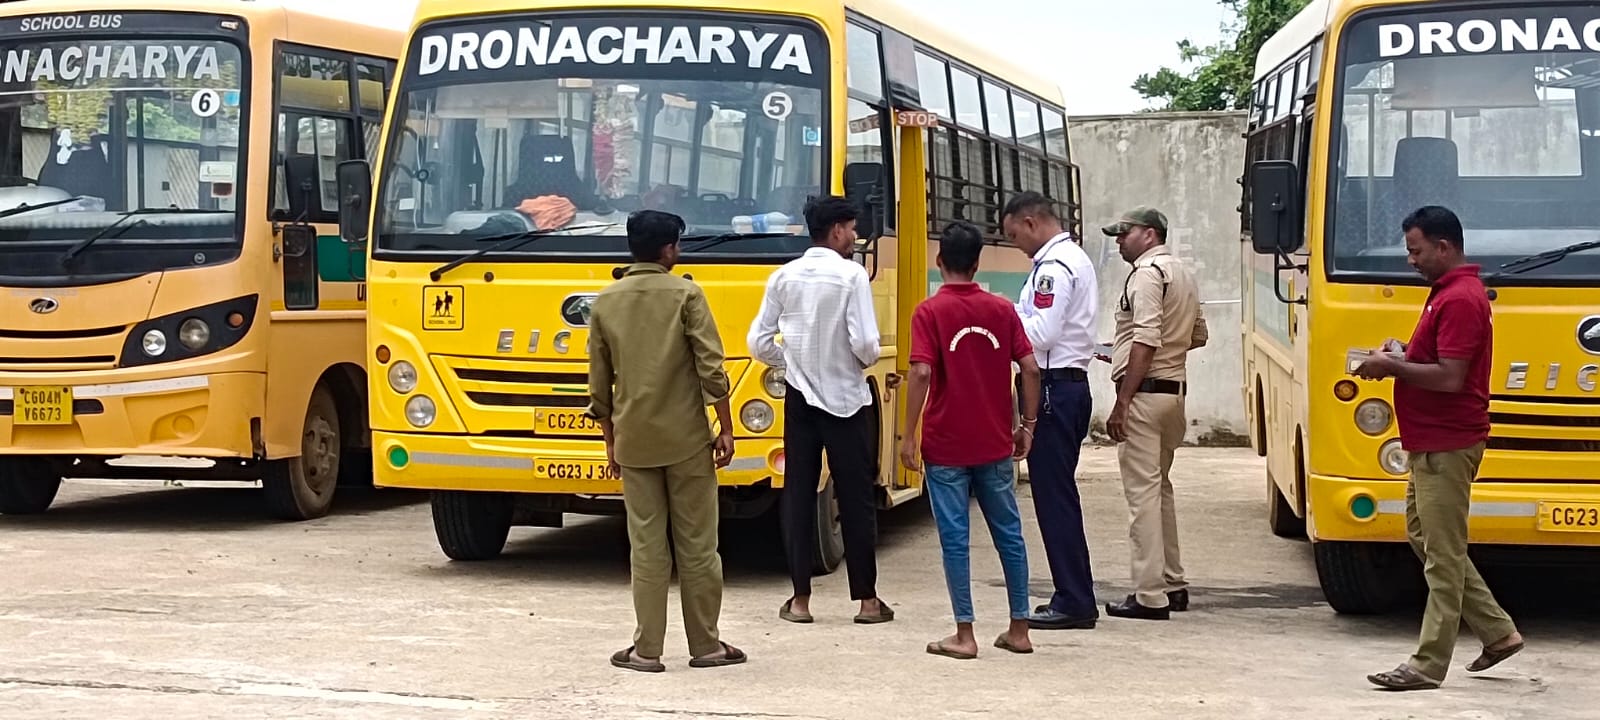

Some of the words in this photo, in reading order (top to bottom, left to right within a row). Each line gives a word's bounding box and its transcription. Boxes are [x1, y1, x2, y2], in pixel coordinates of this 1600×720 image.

[20, 15, 84, 31] SCHOOL
[89, 14, 122, 28] BUS
[418, 25, 813, 76] DRONACHARYA
[0, 45, 220, 83] NACHARYA
[198, 93, 211, 112] 6
[767, 96, 786, 114] 5
[897, 112, 937, 126] STOP
[496, 329, 592, 354] EIC
[24, 407, 61, 421] V6673
[548, 413, 602, 429] CG23J
[547, 463, 582, 479] CG23
[586, 464, 594, 479] J
[1552, 507, 1598, 526] CG23
